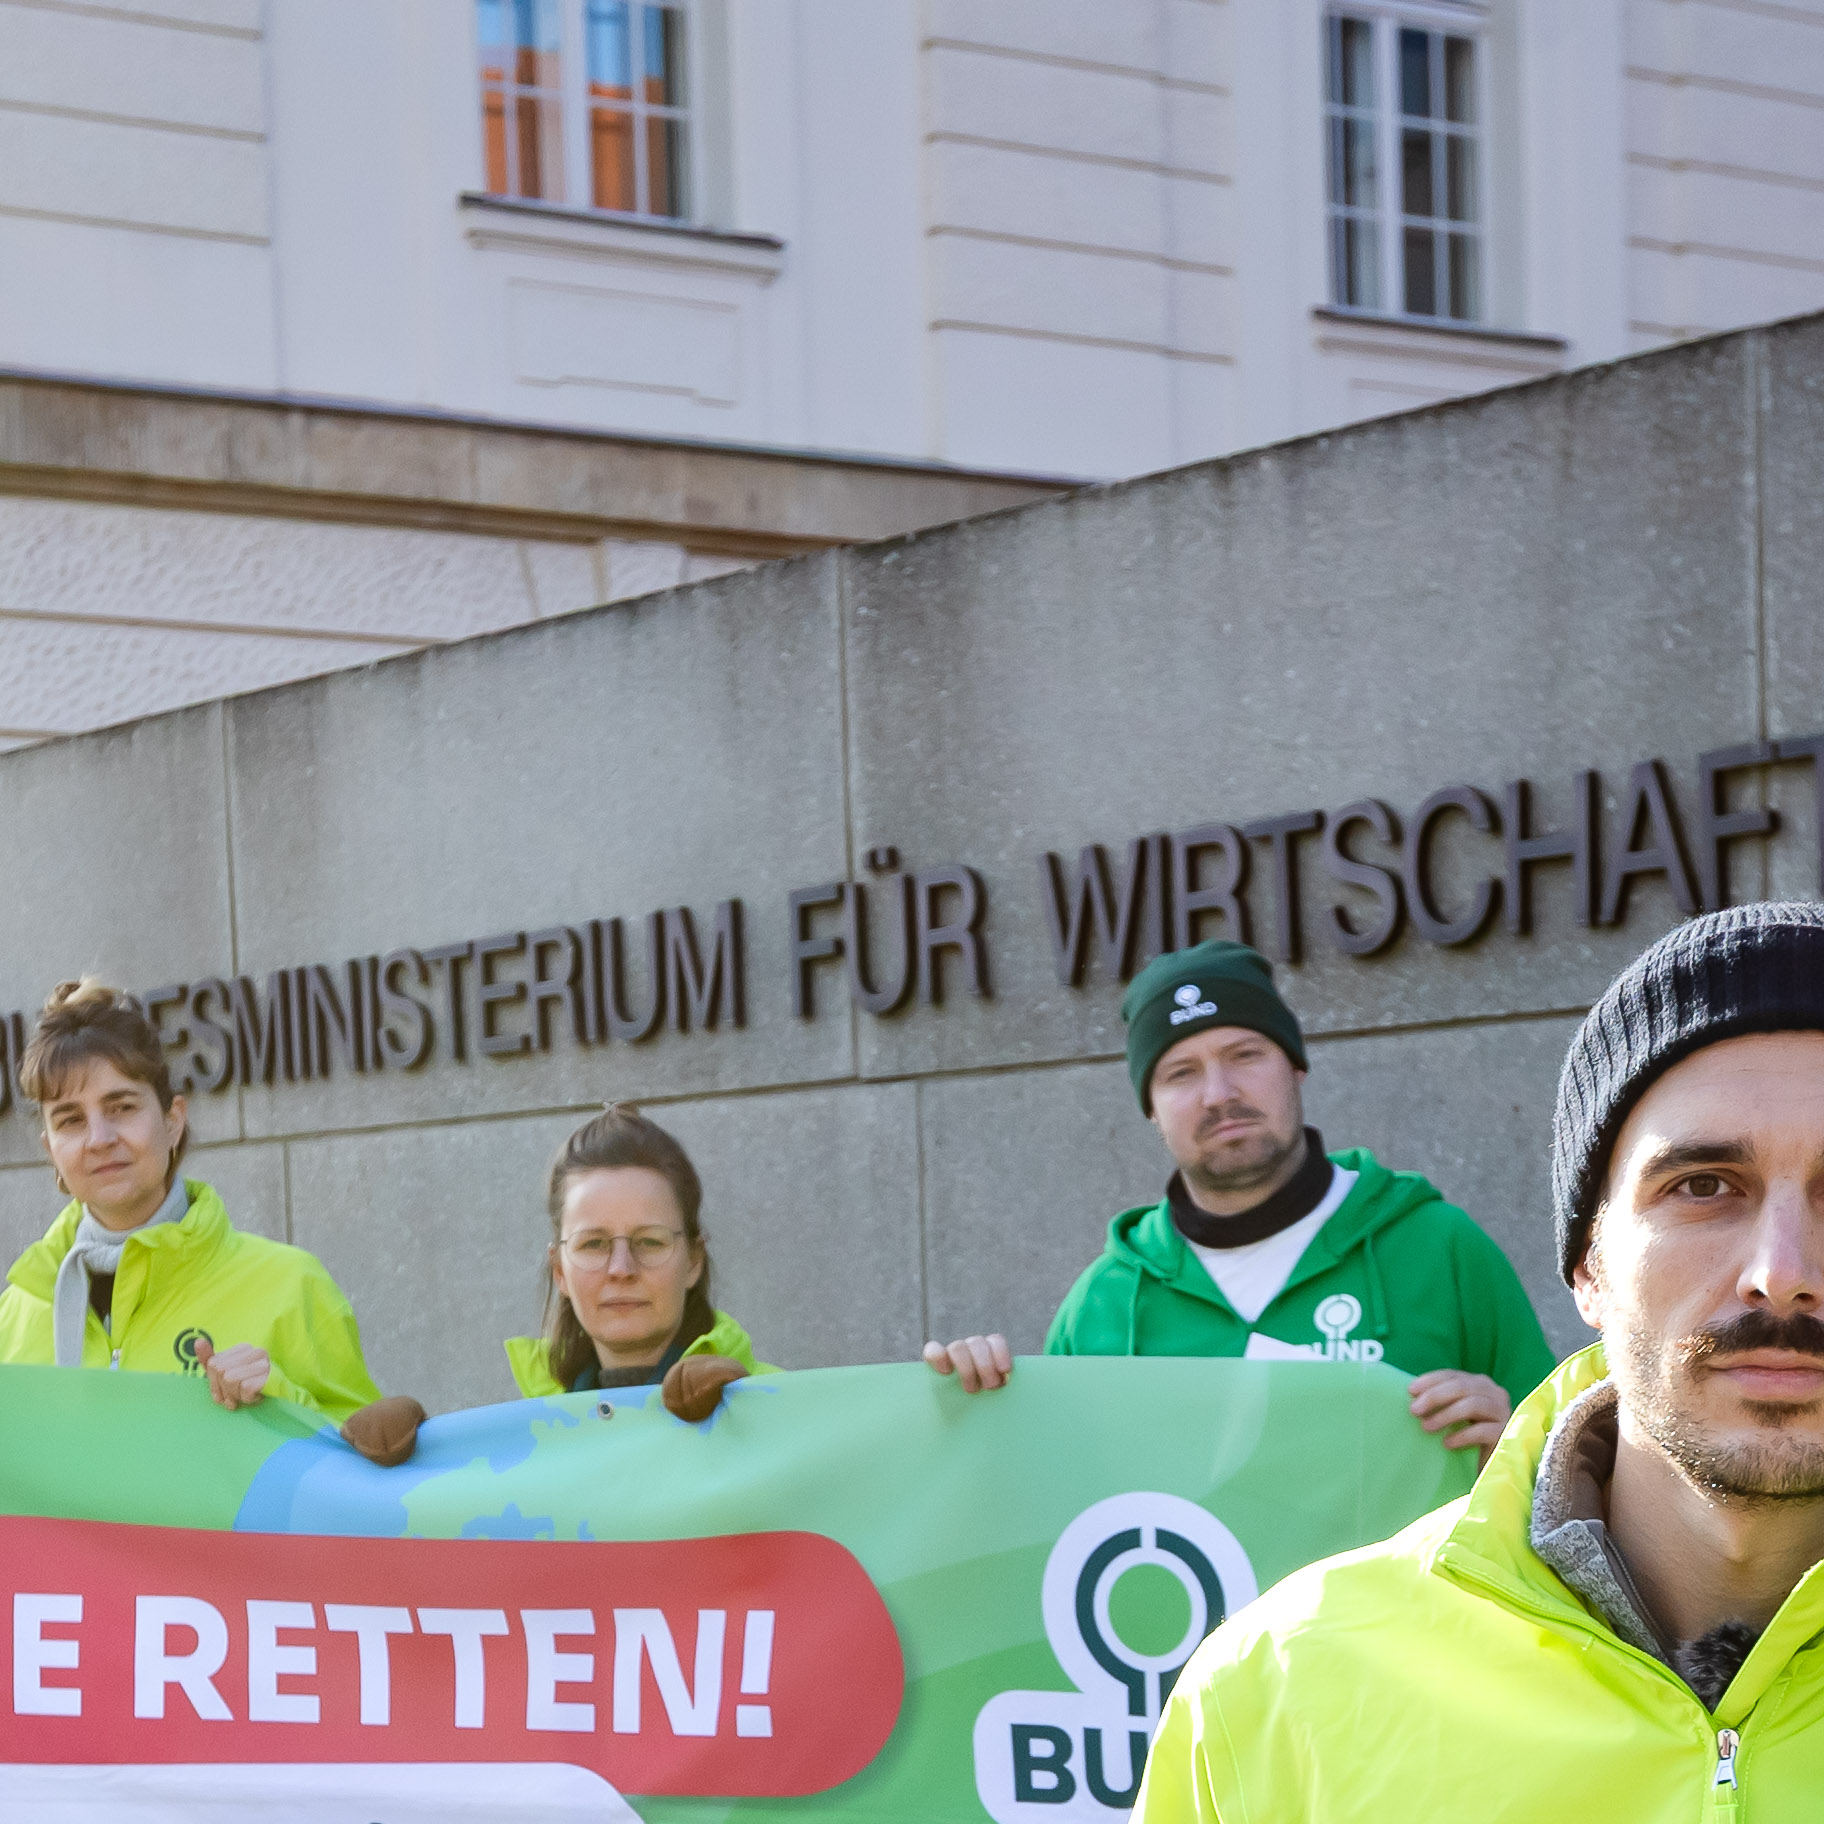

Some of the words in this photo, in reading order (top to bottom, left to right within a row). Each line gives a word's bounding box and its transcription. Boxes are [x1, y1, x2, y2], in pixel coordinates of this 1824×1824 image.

[789, 849, 994, 1019] FÜR
[133, 1594, 775, 1739] RETTEN!
[1010, 1722, 1149, 1810] BU
